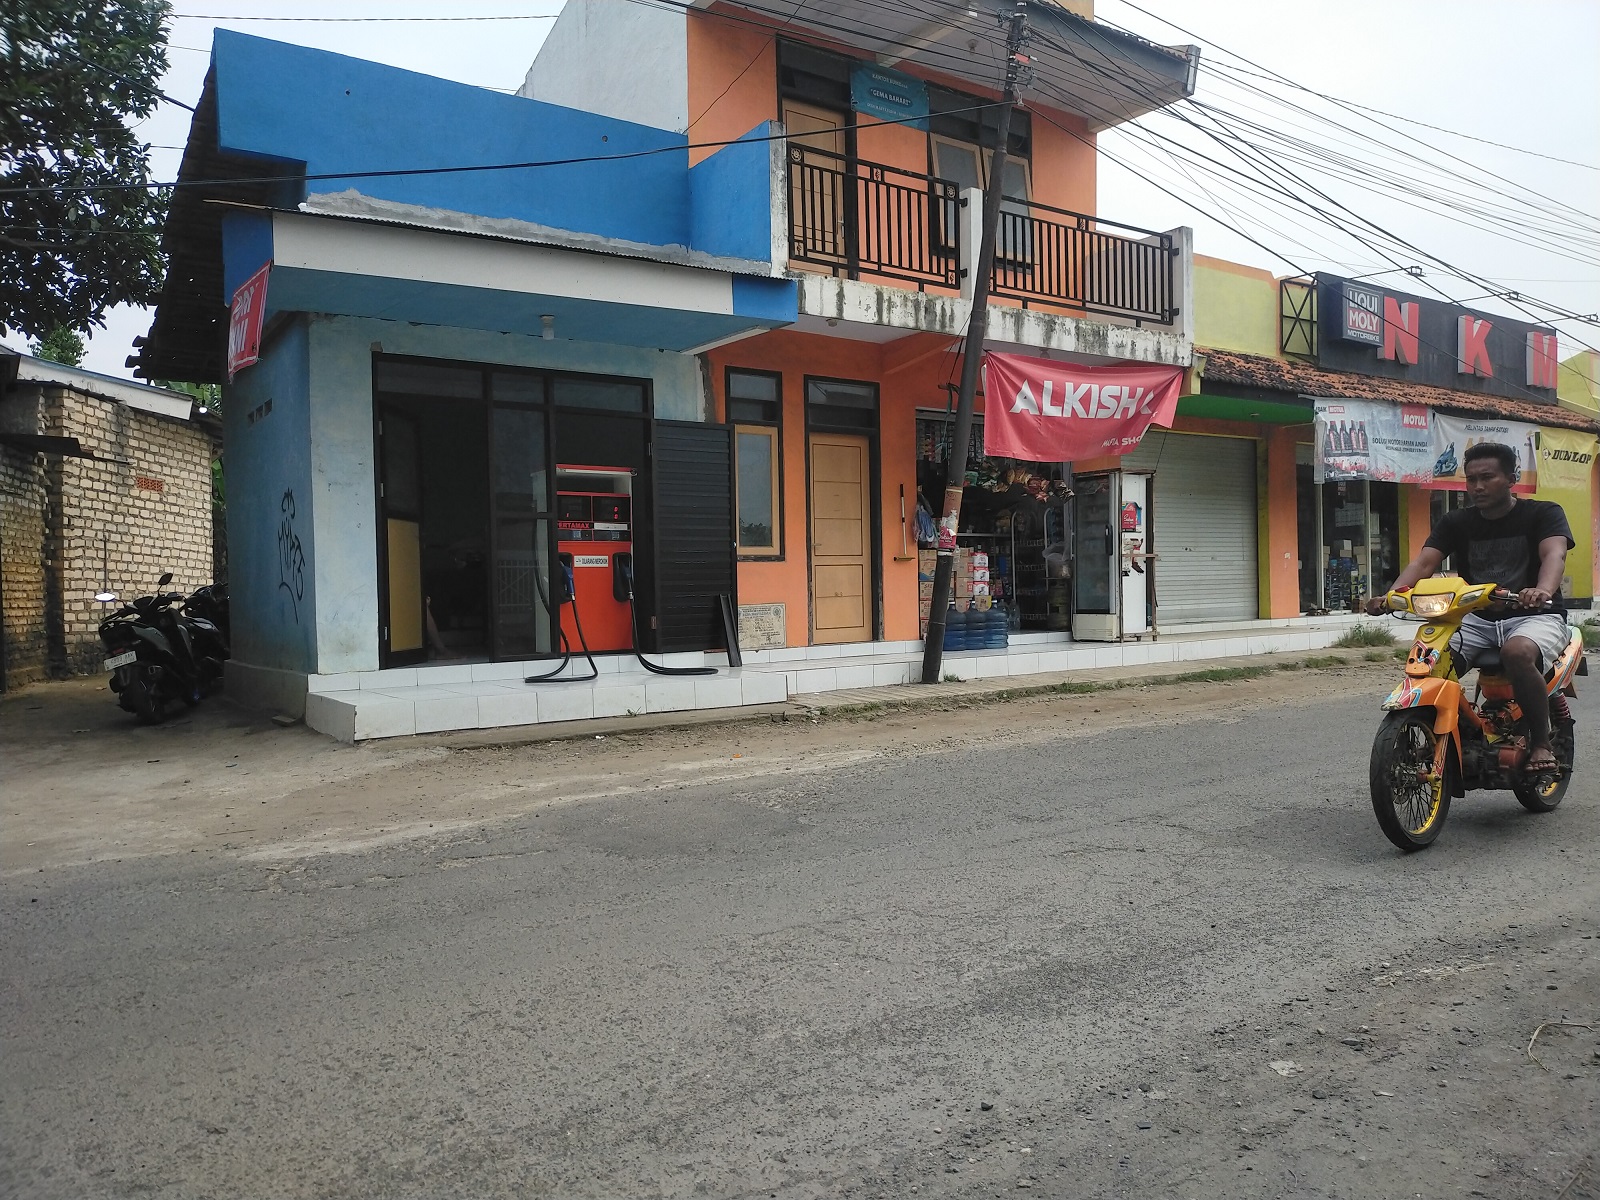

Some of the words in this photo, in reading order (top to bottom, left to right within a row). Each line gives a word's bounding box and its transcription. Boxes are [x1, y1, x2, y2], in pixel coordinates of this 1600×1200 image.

[1350, 290, 1379, 312] LIQUI
[1350, 308, 1379, 334] MOLY
[1347, 329, 1380, 343] MOTORBIKE
[1403, 414, 1427, 426] MOTUL
[1552, 449, 1592, 464] DUNLOP
